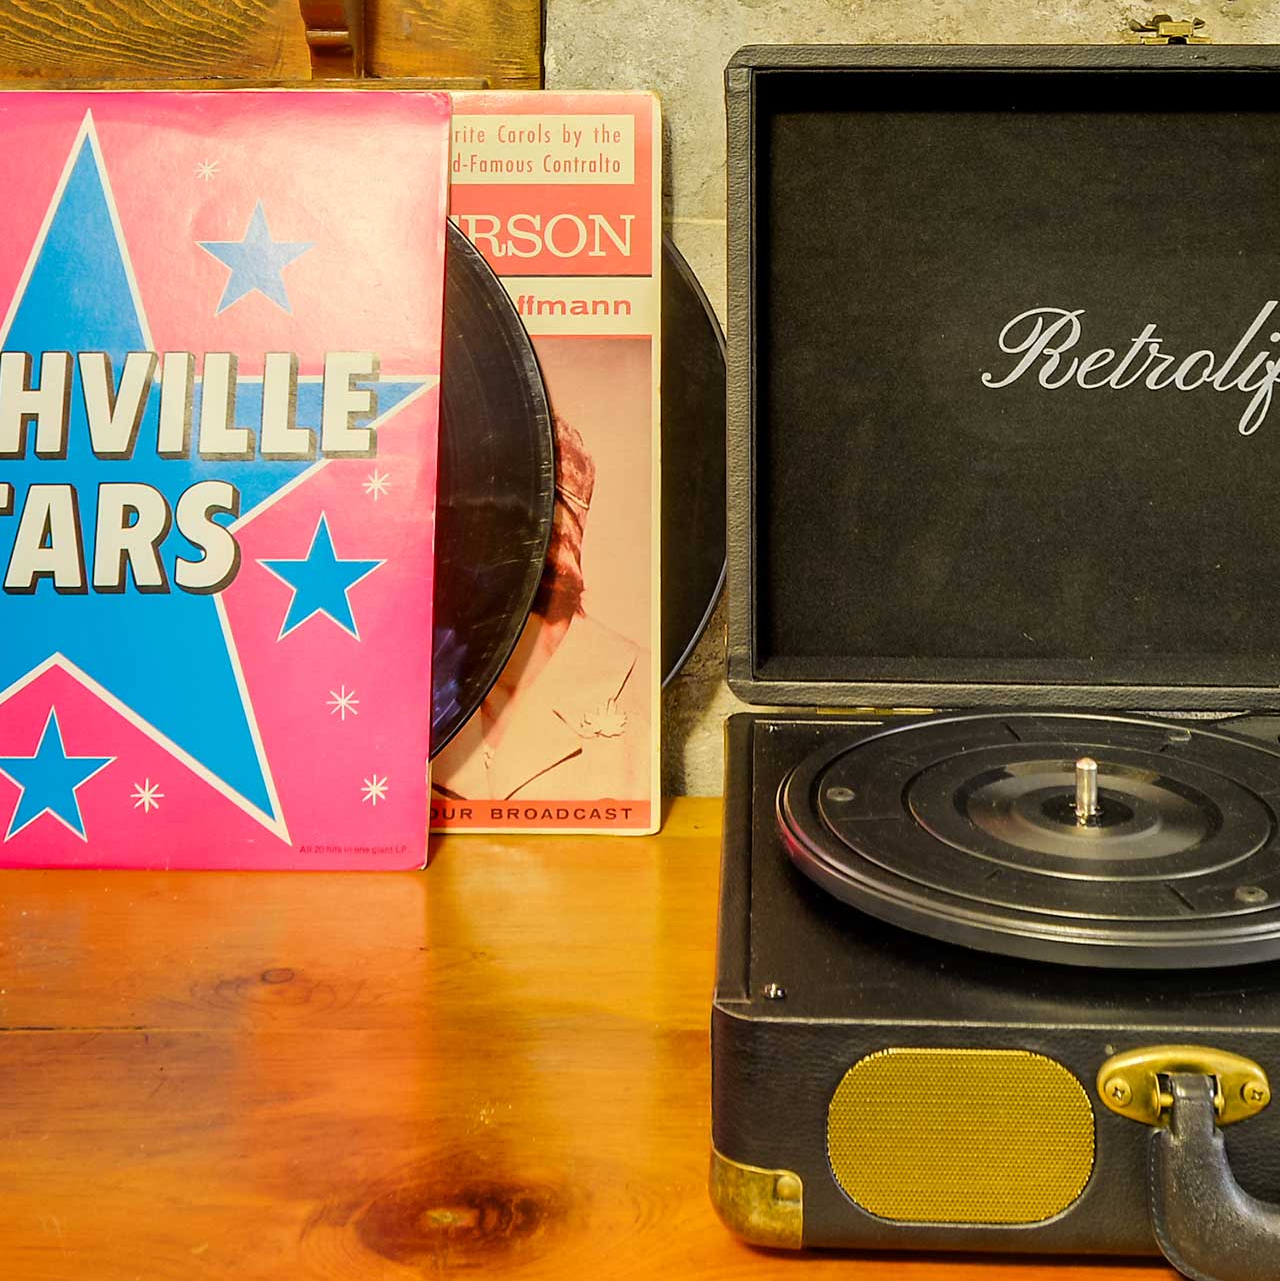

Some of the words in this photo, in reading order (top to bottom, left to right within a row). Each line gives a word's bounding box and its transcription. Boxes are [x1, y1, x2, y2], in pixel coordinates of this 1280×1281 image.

[454, 125, 485, 143] rite
[498, 123, 552, 143] Carols
[562, 124, 582, 148] by
[593, 123, 621, 143] the
[453, 152, 533, 173] d-Famous
[543, 154, 621, 173] Contralto
[451, 213, 636, 258] RSON
[517, 295, 632, 315] ffmann
[430, 807, 473, 820] OUR
[490, 807, 634, 821] BROADCAST
